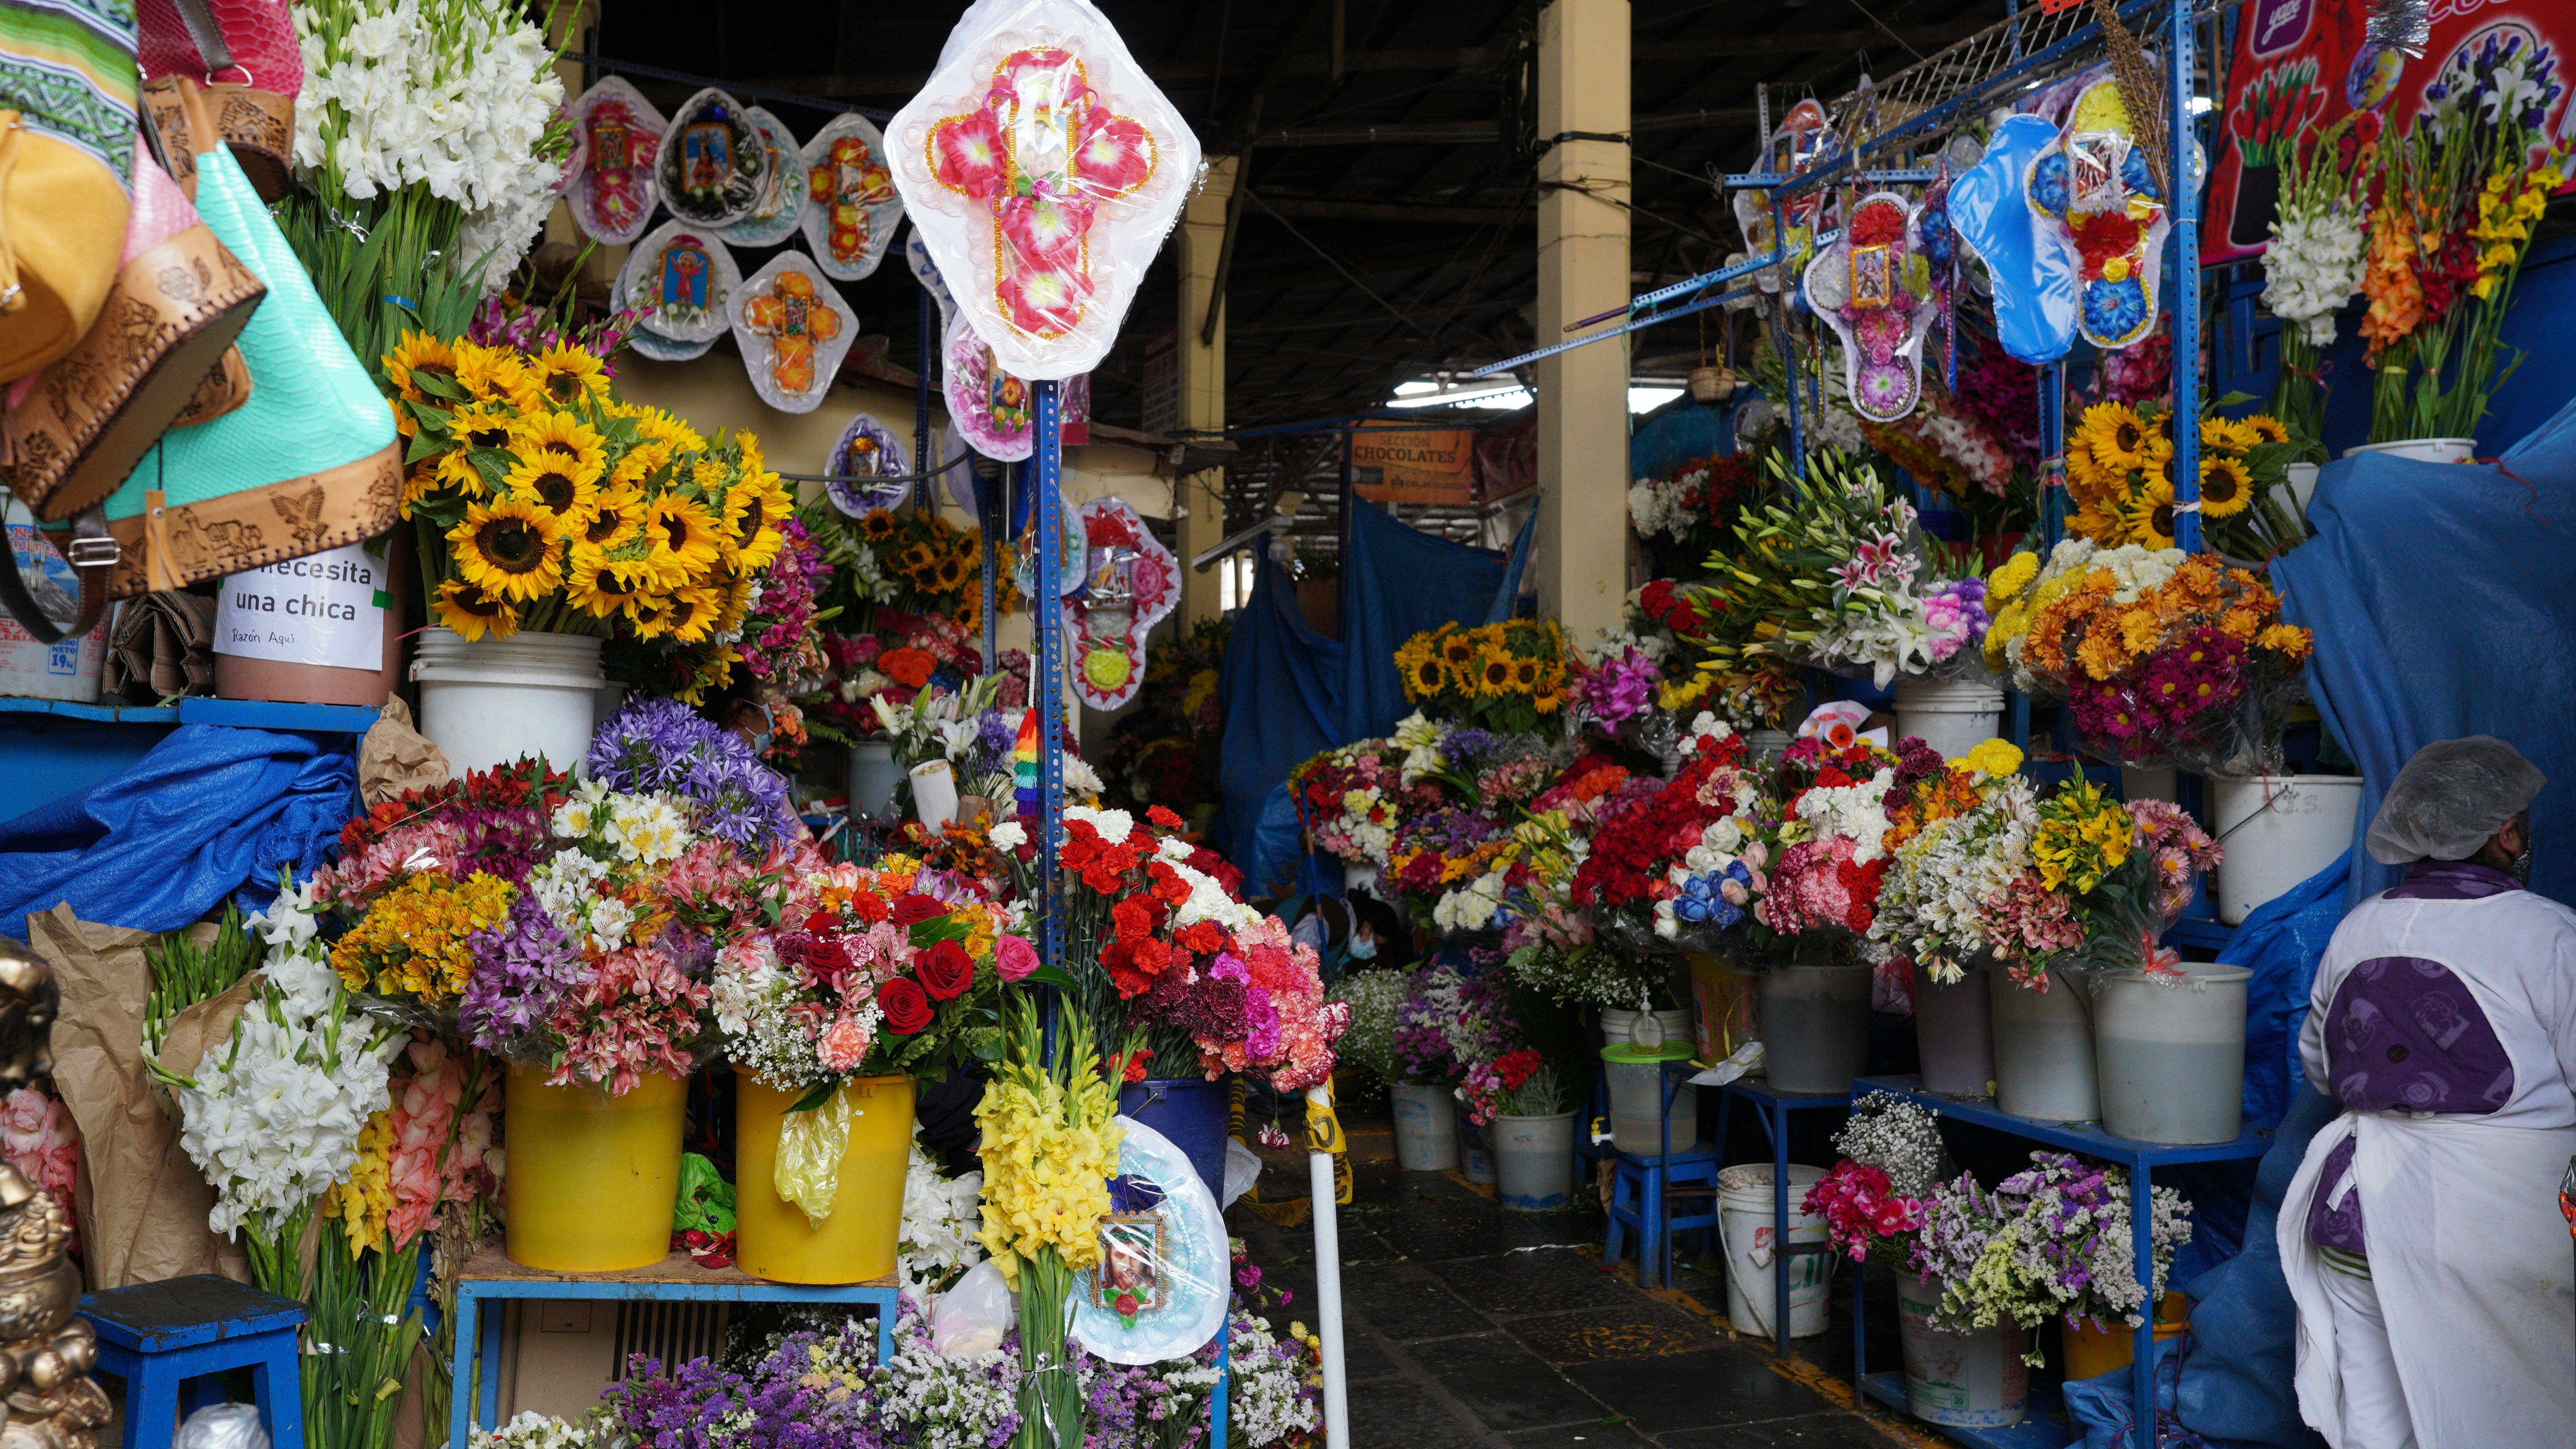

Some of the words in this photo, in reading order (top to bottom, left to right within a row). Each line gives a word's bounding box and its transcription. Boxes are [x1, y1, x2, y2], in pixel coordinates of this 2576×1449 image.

[1380, 434, 1430, 447] SECCIÓN
[1355, 446, 1456, 463] CHOCOLATES
[236, 593, 275, 612] una
[286, 594, 355, 621] chica
[232, 629, 261, 643] Razón
[52, 646, 76, 654] NETO
[52, 654, 67, 668] 19
